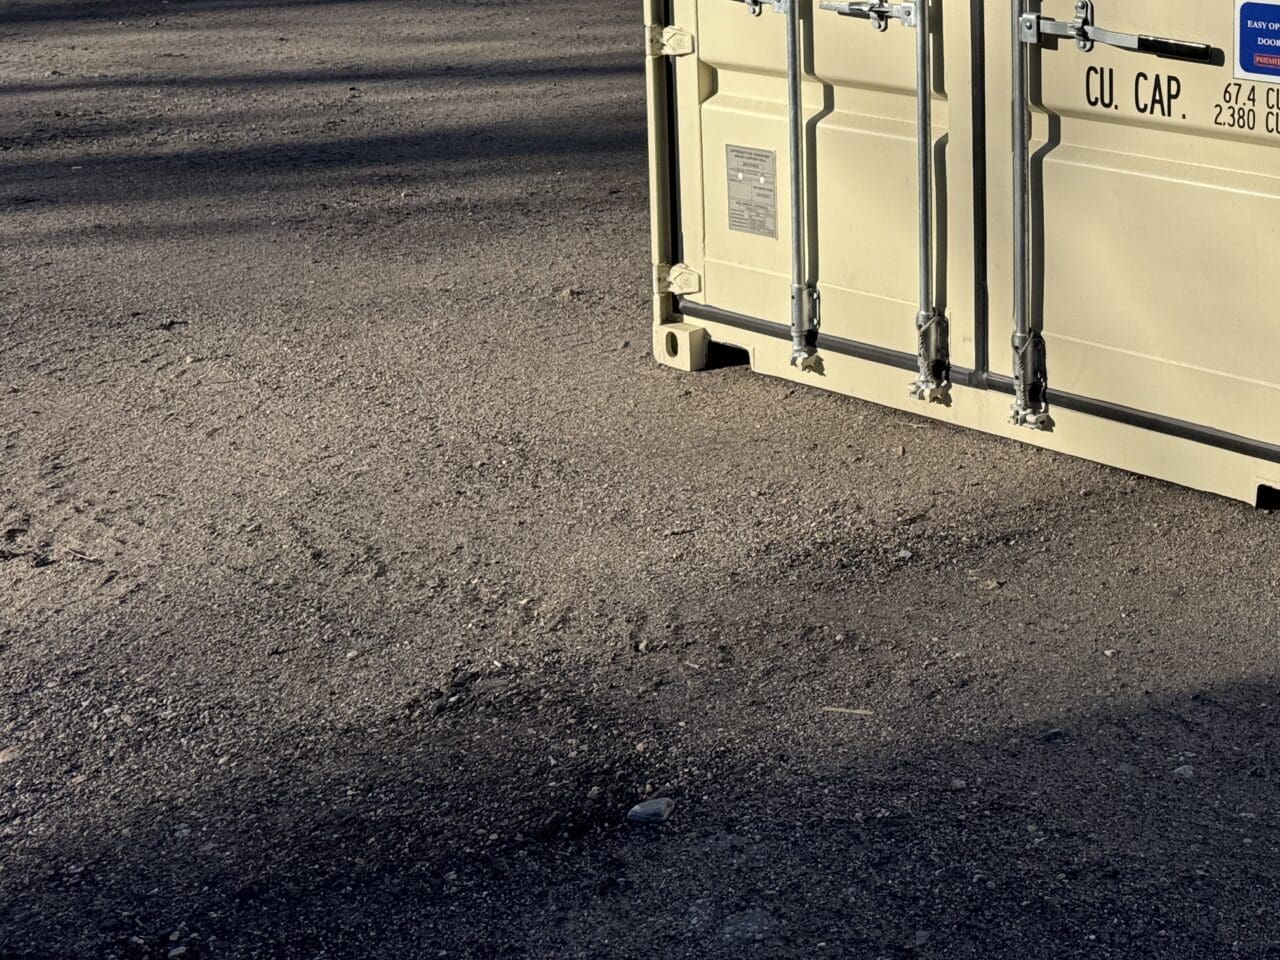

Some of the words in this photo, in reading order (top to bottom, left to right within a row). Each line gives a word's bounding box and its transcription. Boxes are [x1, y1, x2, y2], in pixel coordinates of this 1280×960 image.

[1247, 20, 1267, 30] EASY
[1085, 65, 1119, 110] CU.
[1134, 71, 1186, 120] CAP.
[1223, 82, 1256, 109] 67.4
